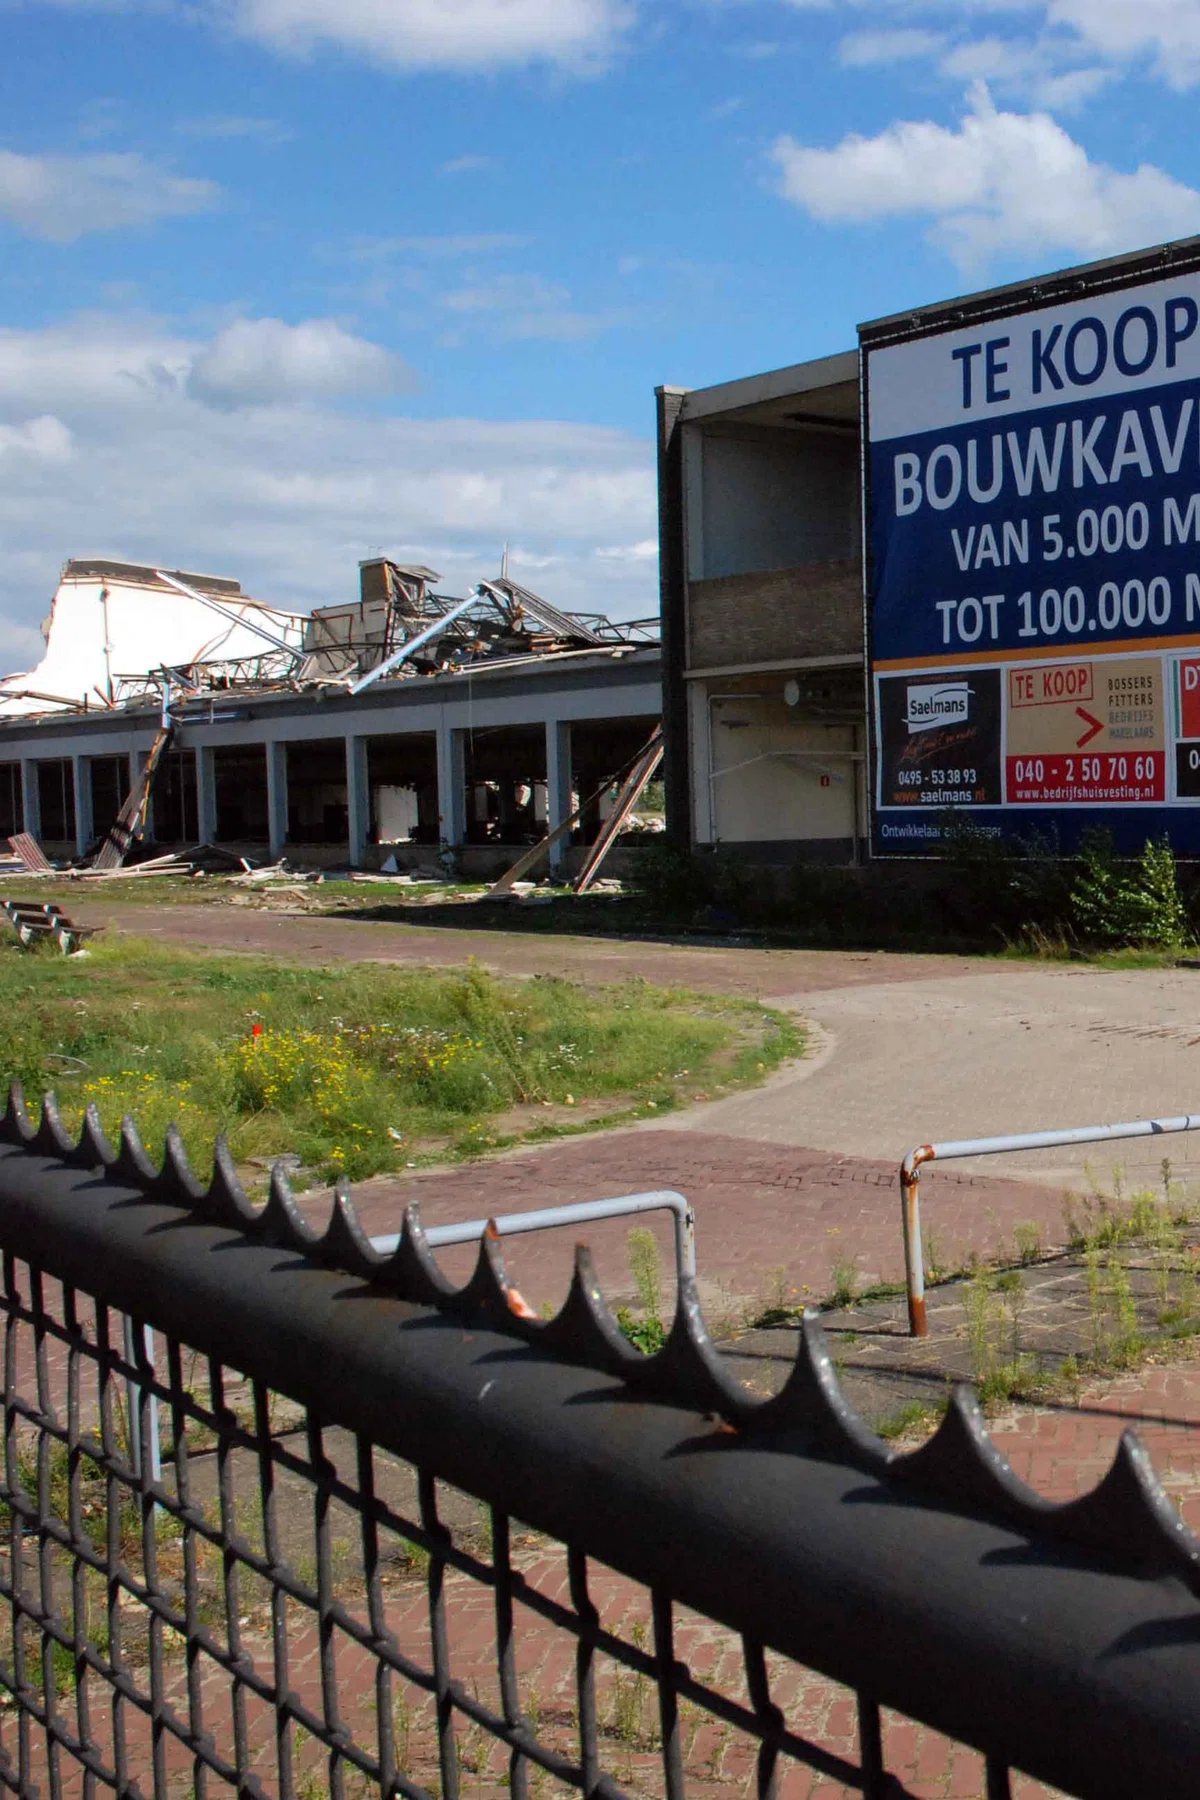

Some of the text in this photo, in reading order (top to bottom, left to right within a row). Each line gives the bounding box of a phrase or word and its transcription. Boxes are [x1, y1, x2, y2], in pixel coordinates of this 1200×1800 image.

[952, 296, 1199, 409] TE KOOP
[951, 518, 1030, 571] VAN
[1042, 504, 1150, 561] 5.000
[936, 594, 1005, 643] TOT
[1017, 575, 1171, 637] 100.000
[1015, 668, 1088, 700] TE KOOP
[1108, 675, 1153, 691] BOSSERS
[910, 695, 966, 716] Saelmans
[1108, 692, 1153, 707] FITTERS
[898, 770, 922, 786] 0495
[931, 769, 945, 785] 53
[947, 769, 961, 784] 38
[963, 768, 977, 784] 93
[1015, 759, 1044, 782] 040
[1065, 758, 1075, 782] 2
[1081, 758, 1101, 782] 50
[1108, 757, 1128, 780] 70
[1134, 756, 1155, 780] 60
[1015, 785, 1154, 801] www.bedrijfshuisvesting.nl
[881, 823, 941, 839] Ontwikkelaar
